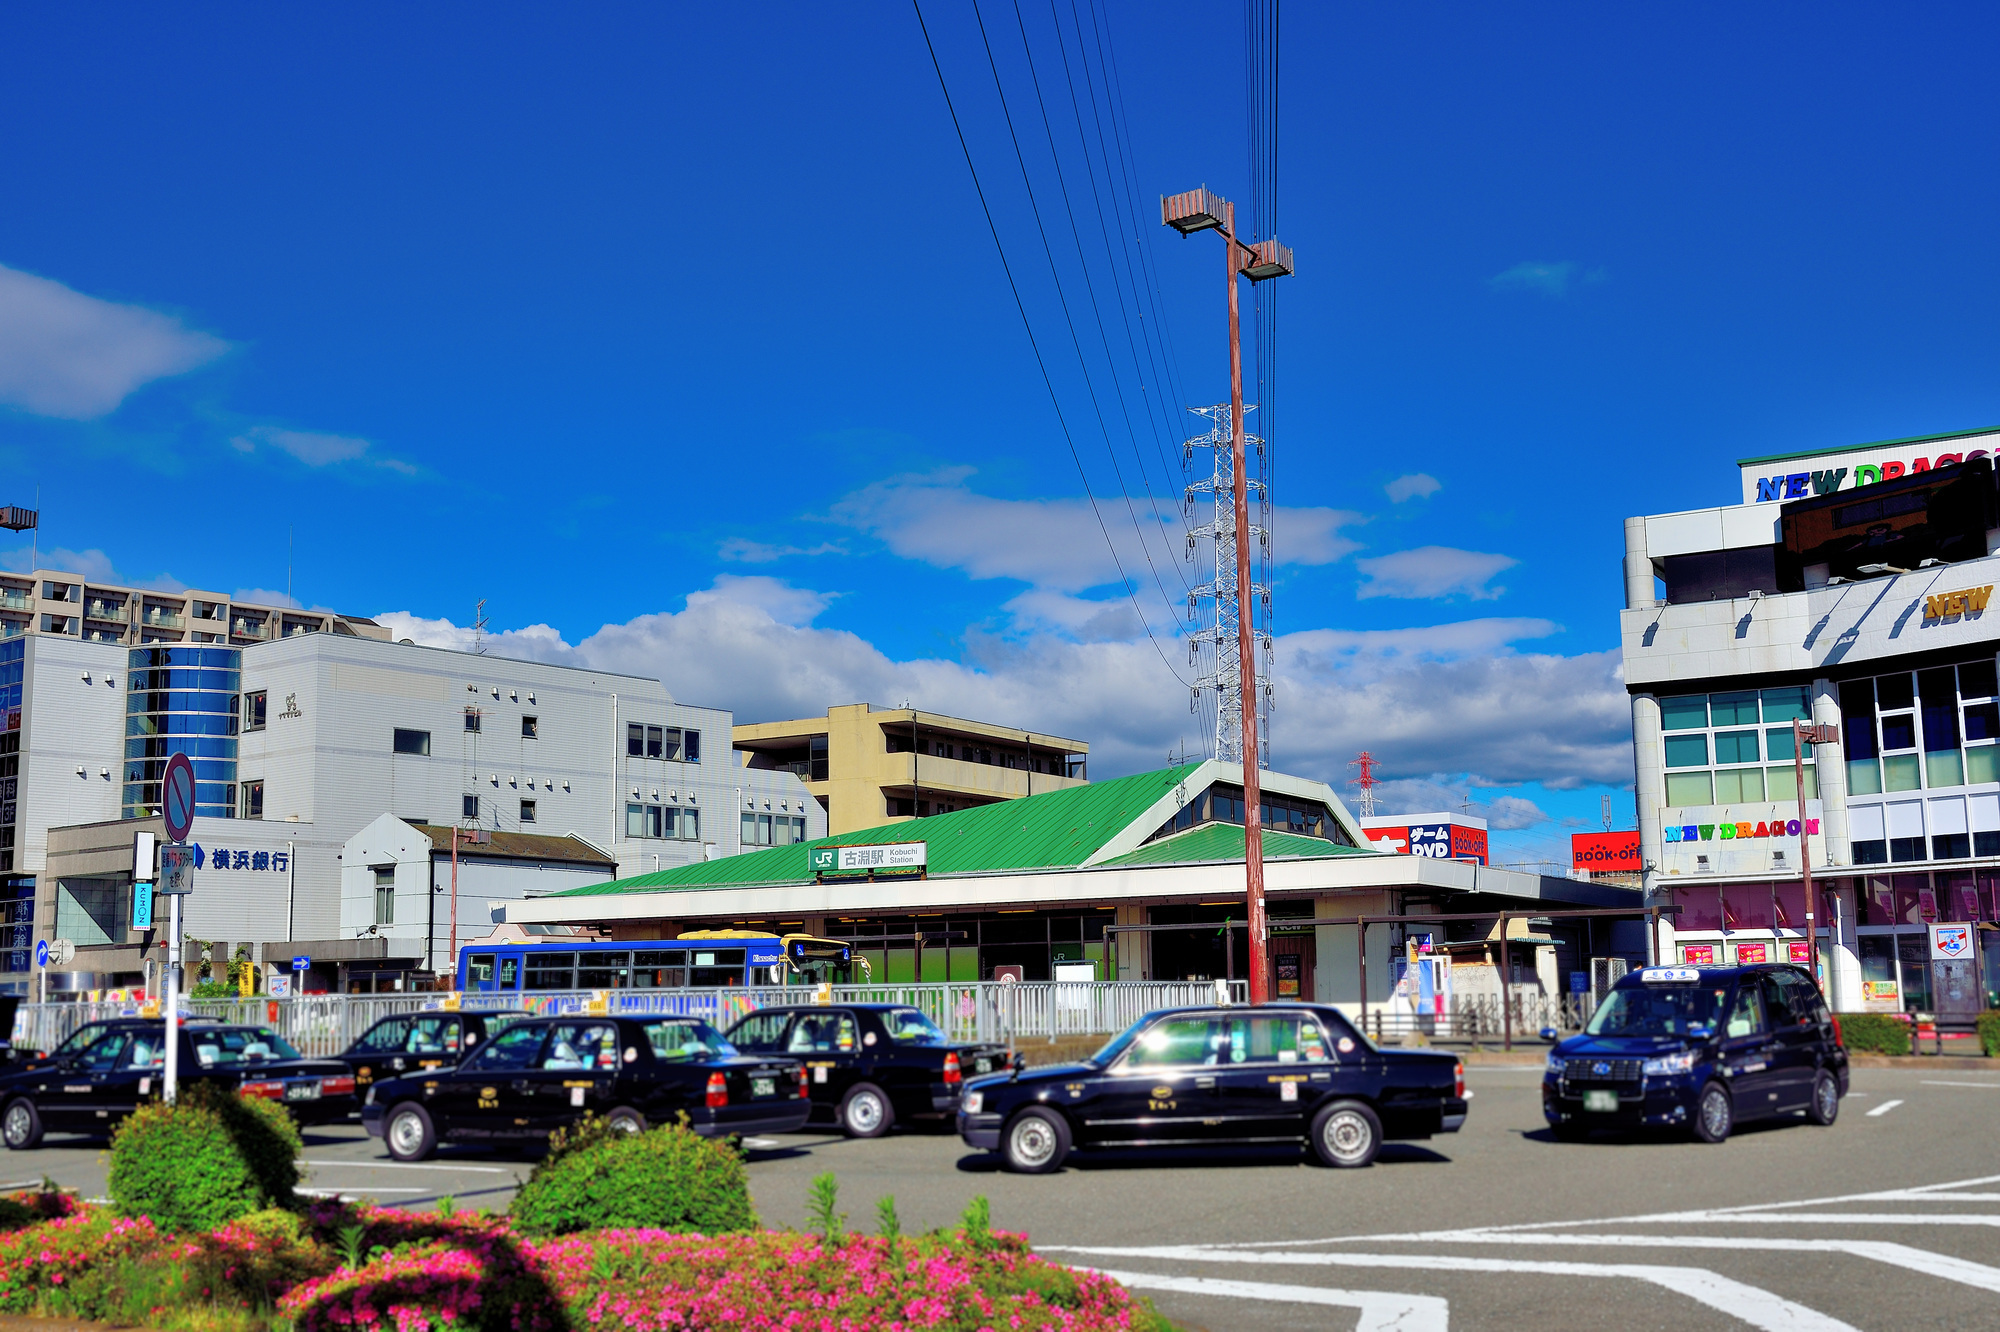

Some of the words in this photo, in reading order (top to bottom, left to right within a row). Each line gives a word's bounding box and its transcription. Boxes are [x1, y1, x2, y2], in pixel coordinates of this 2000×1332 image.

[1756, 467, 1848, 503] NEW
[1853, 447, 2000, 488] DRA
[1925, 585, 1994, 619] NEW
[1410, 827, 1449, 842] ゲーム
[1665, 824, 1715, 842] NEW
[1719, 819, 1820, 840] DRAGON
[815, 852, 833, 864] JR
[889, 848, 918, 856] Kobuchi
[1412, 842, 1448, 858] DVD
[212, 848, 289, 872] 横浜銀行
[889, 856, 914, 864] Station
[138, 887, 147, 923] KUMON
